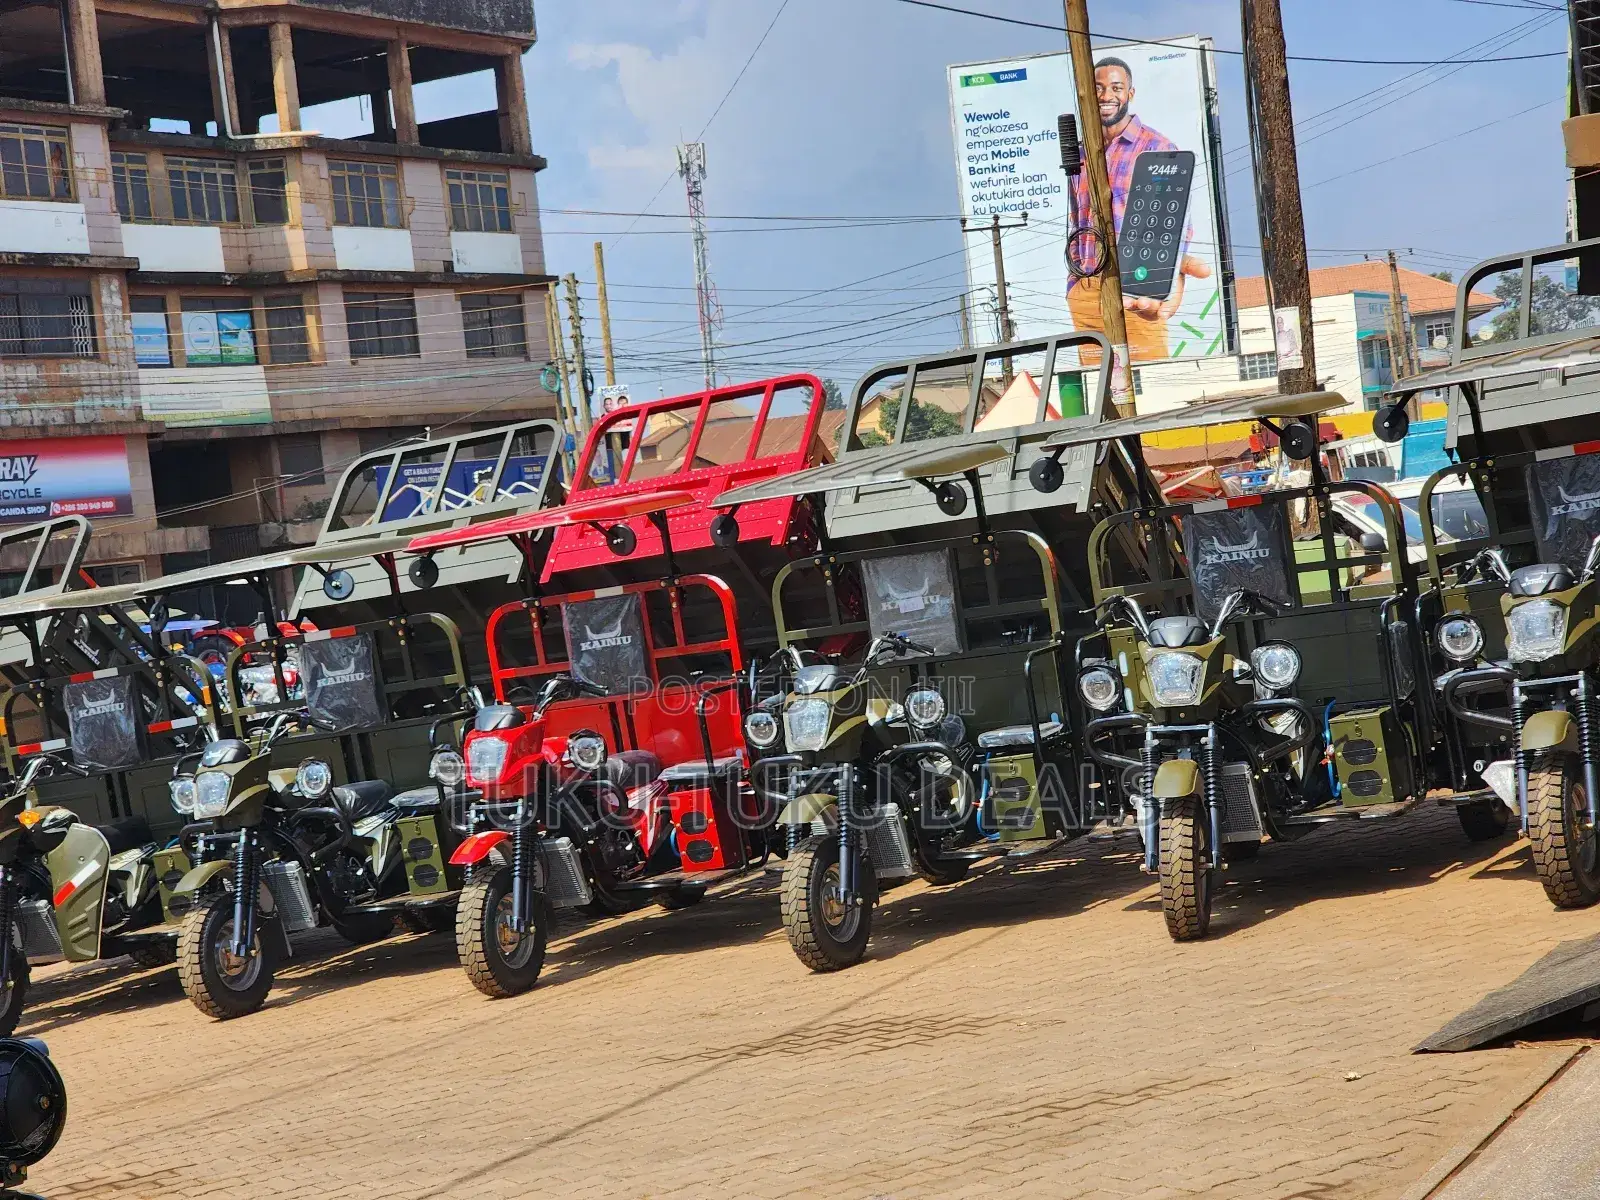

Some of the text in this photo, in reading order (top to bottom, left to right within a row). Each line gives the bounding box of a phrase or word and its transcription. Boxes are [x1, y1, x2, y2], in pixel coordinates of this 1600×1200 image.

[1149, 52, 1187, 62] #BankBetter
[971, 72, 1018, 84] KCB BANK
[964, 109, 1010, 123] Wewole
[966, 129, 1058, 150] empereza yaffe
[967, 147, 1029, 164] eya Mobile
[969, 162, 1016, 176] Banking
[970, 173, 1048, 189] wefunire loan
[971, 183, 1061, 202] okutukira ddala
[972, 197, 1053, 215] ku bukadde 5.
[0, 488, 42, 500] CYCLE
[26, 505, 47, 515] SHOP
[1205, 548, 1270, 565] KAINIU
[580, 635, 632, 651] KAINIU
[316, 672, 366, 688] KAINIU
[78, 702, 125, 718] KAINIU
